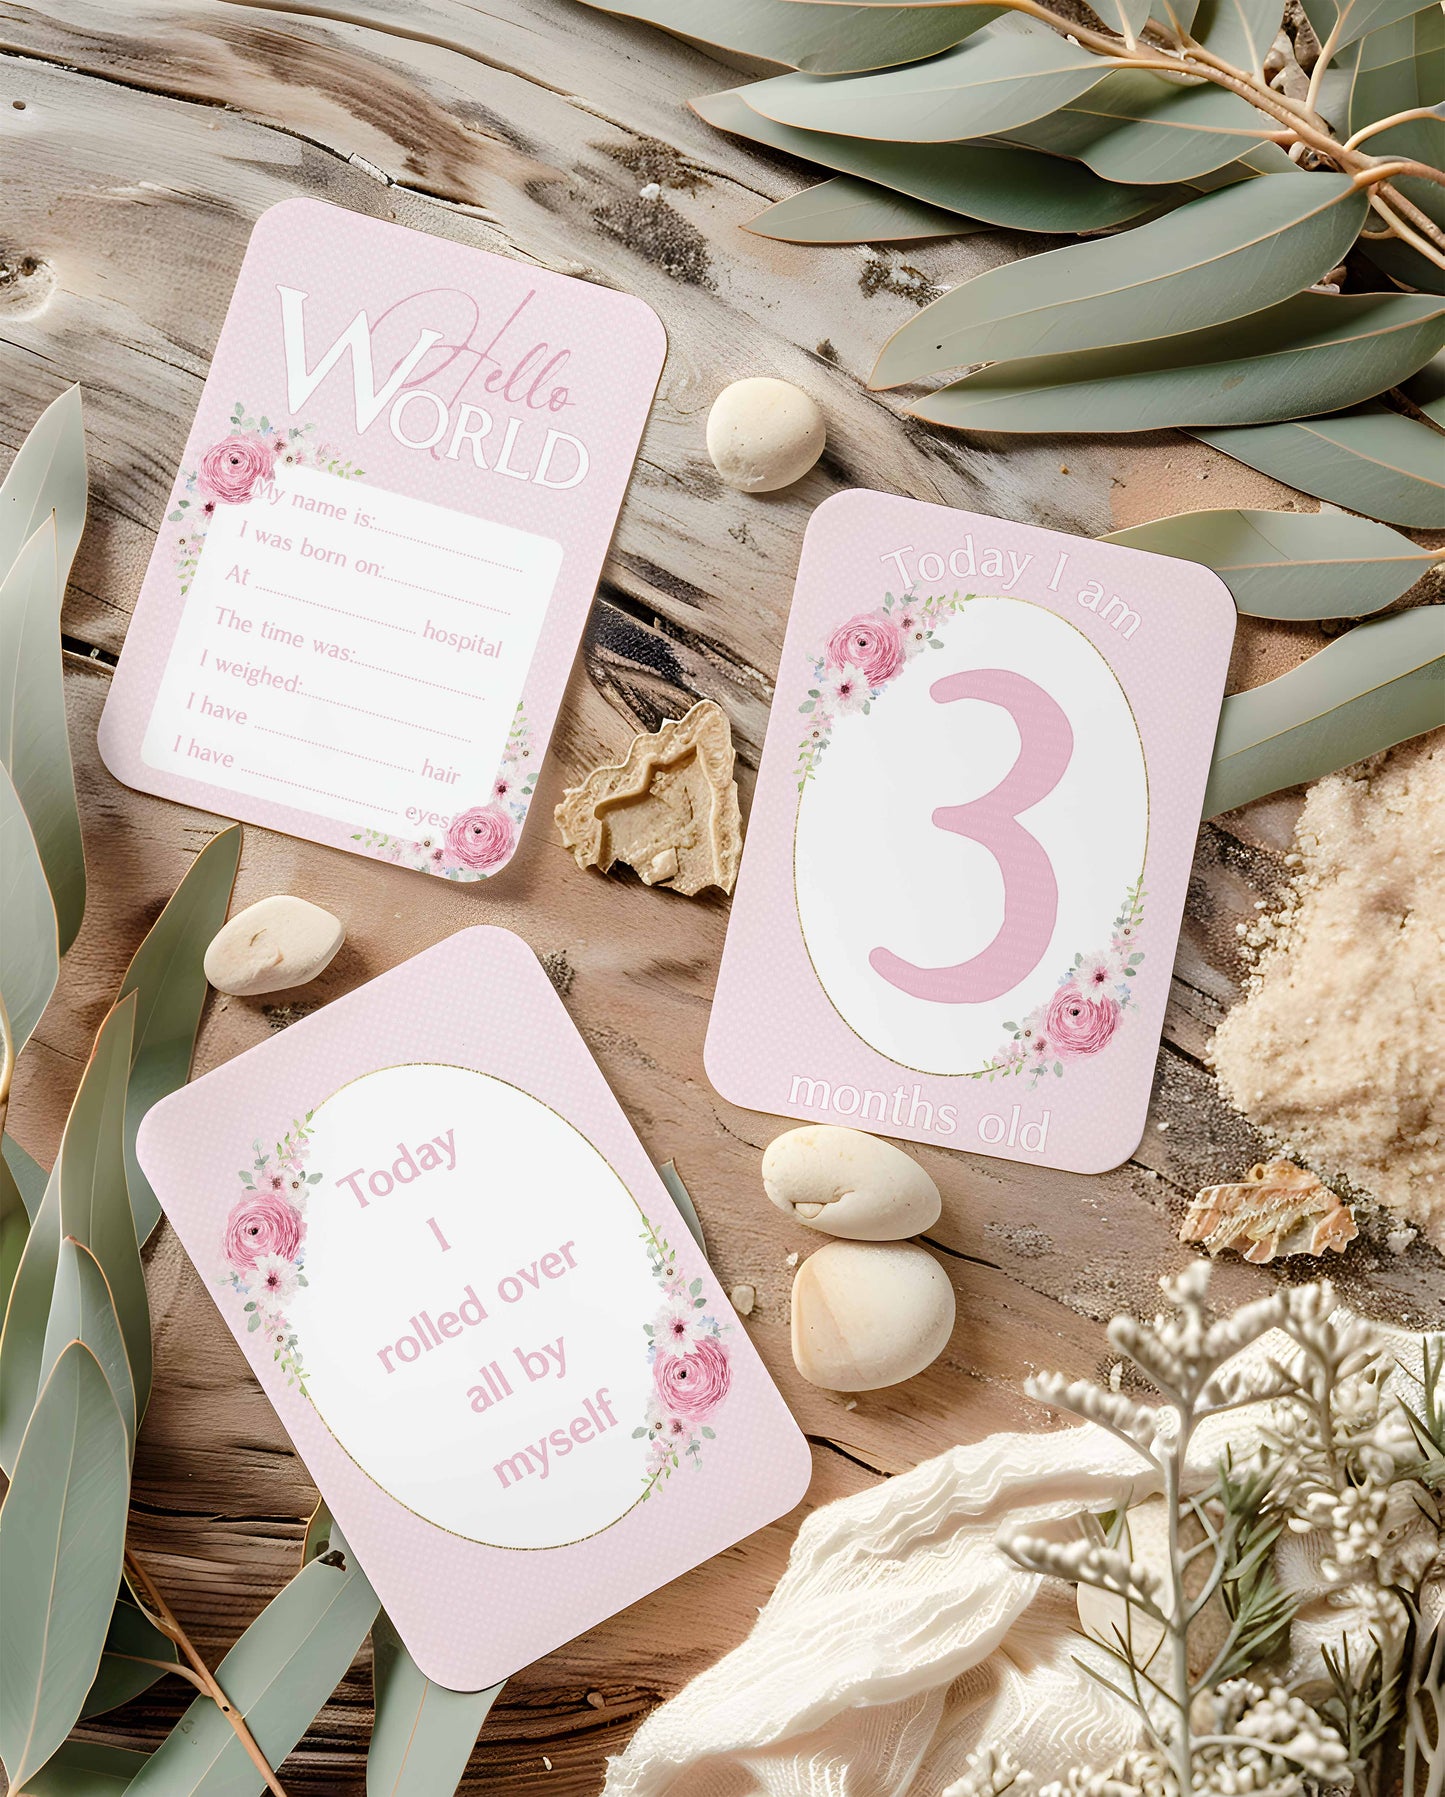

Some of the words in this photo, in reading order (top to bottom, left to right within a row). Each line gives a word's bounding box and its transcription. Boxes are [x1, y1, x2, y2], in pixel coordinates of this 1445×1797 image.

[275, 283, 591, 490] WORLD
[370, 288, 576, 461] Hello
[239, 519, 249, 538] I
[255, 529, 293, 552] was
[300, 537, 347, 567] born
[252, 477, 286, 506] My
[291, 494, 348, 521] name
[217, 606, 253, 634] The
[260, 620, 304, 648] time
[226, 564, 252, 586] At
[423, 620, 503, 661] hospital
[879, 533, 1034, 591] Today
[1047, 551, 1071, 592] I
[1077, 579, 1143, 642] am
[199, 649, 208, 667] I
[173, 735, 183, 753] I
[186, 737, 234, 769] have
[405, 805, 450, 830] eyes
[187, 691, 196, 709] I
[200, 695, 248, 725] have
[421, 759, 462, 787] hair
[867, 667, 1075, 1005] 3
[787, 1074, 959, 1135] months
[977, 1104, 1052, 1152] old
[336, 1128, 458, 1209] Today
[426, 1217, 452, 1254] I
[377, 1284, 488, 1374] rolled
[497, 1239, 577, 1304] over
[465, 1360, 513, 1414] all
[512, 1336, 567, 1383] by
[492, 1387, 619, 1489] myself
